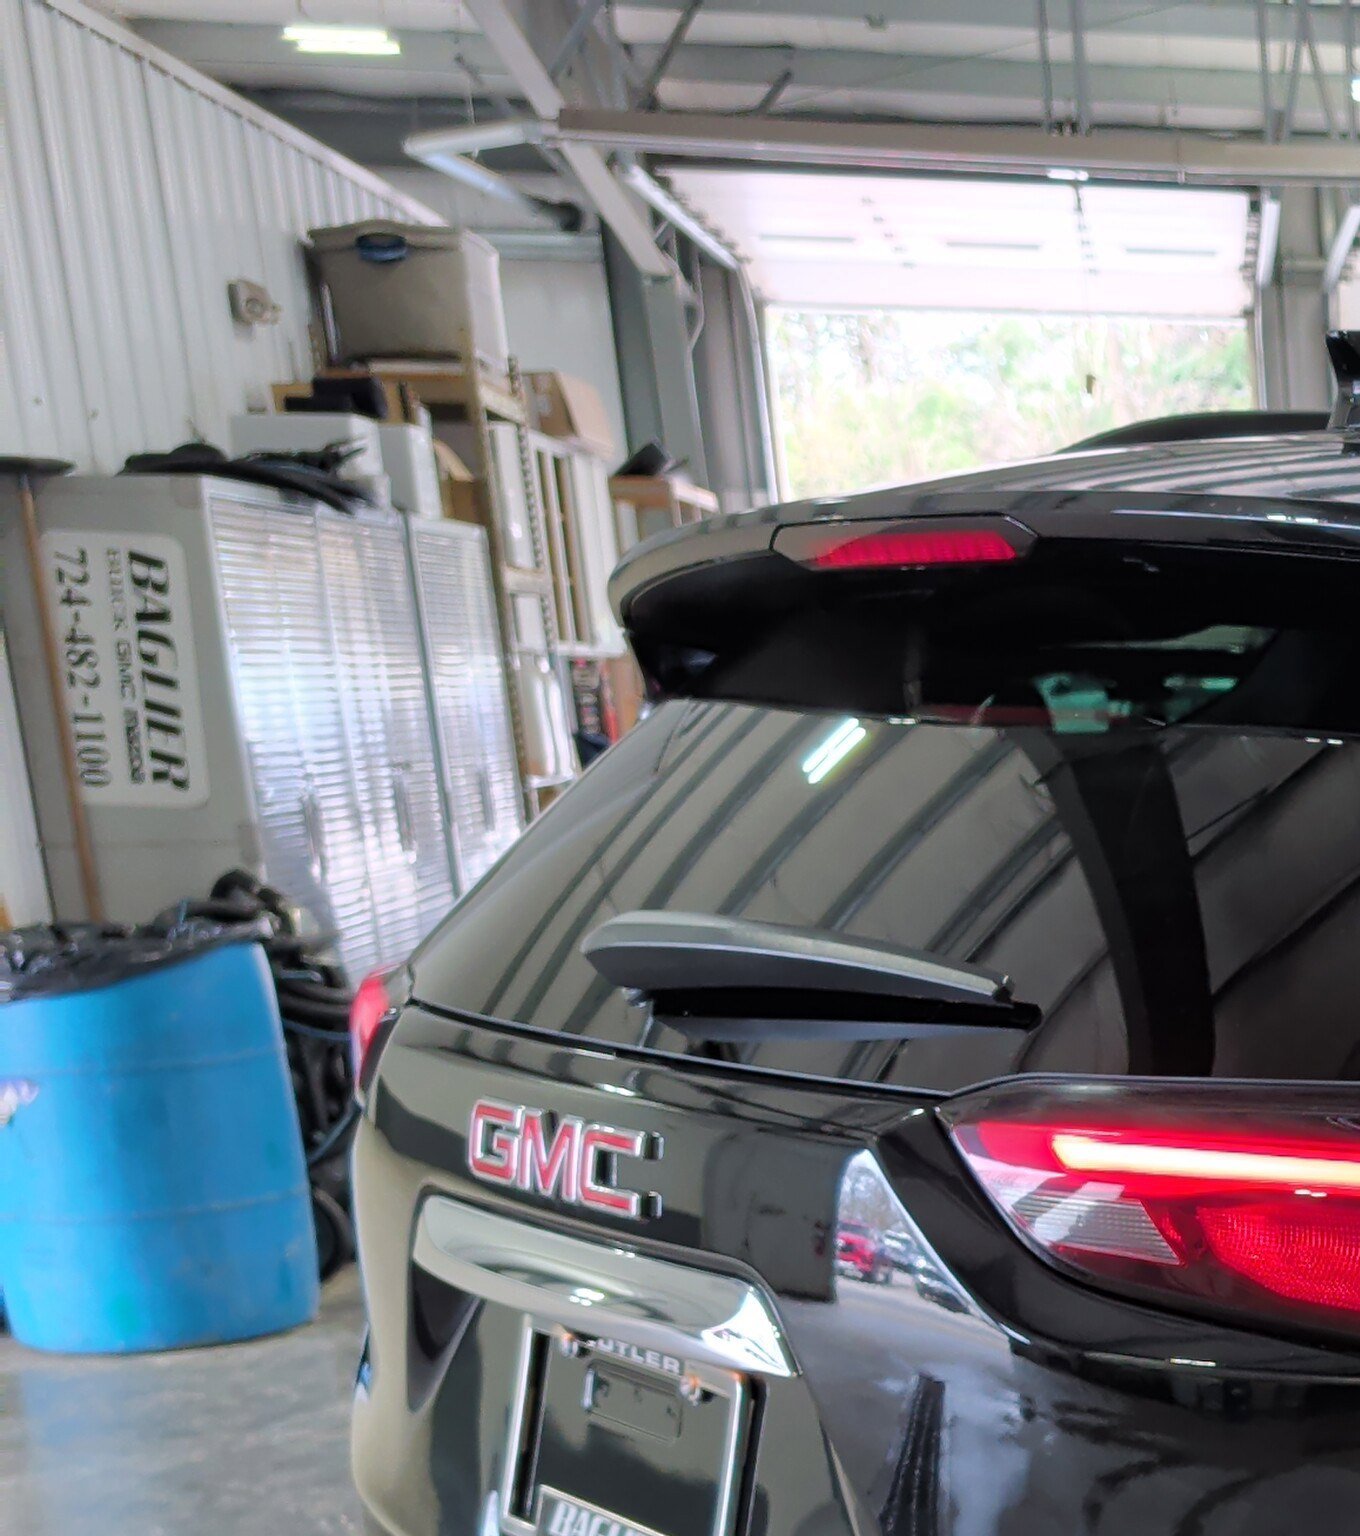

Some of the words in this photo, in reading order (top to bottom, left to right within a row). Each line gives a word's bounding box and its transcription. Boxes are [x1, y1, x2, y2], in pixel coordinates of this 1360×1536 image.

[107, 548, 128, 633] BUICK
[53, 548, 112, 787] 724-482-1100
[116, 639, 136, 700] GMC
[127, 550, 190, 791] BAGLIER
[468, 1098, 647, 1219] GMC
